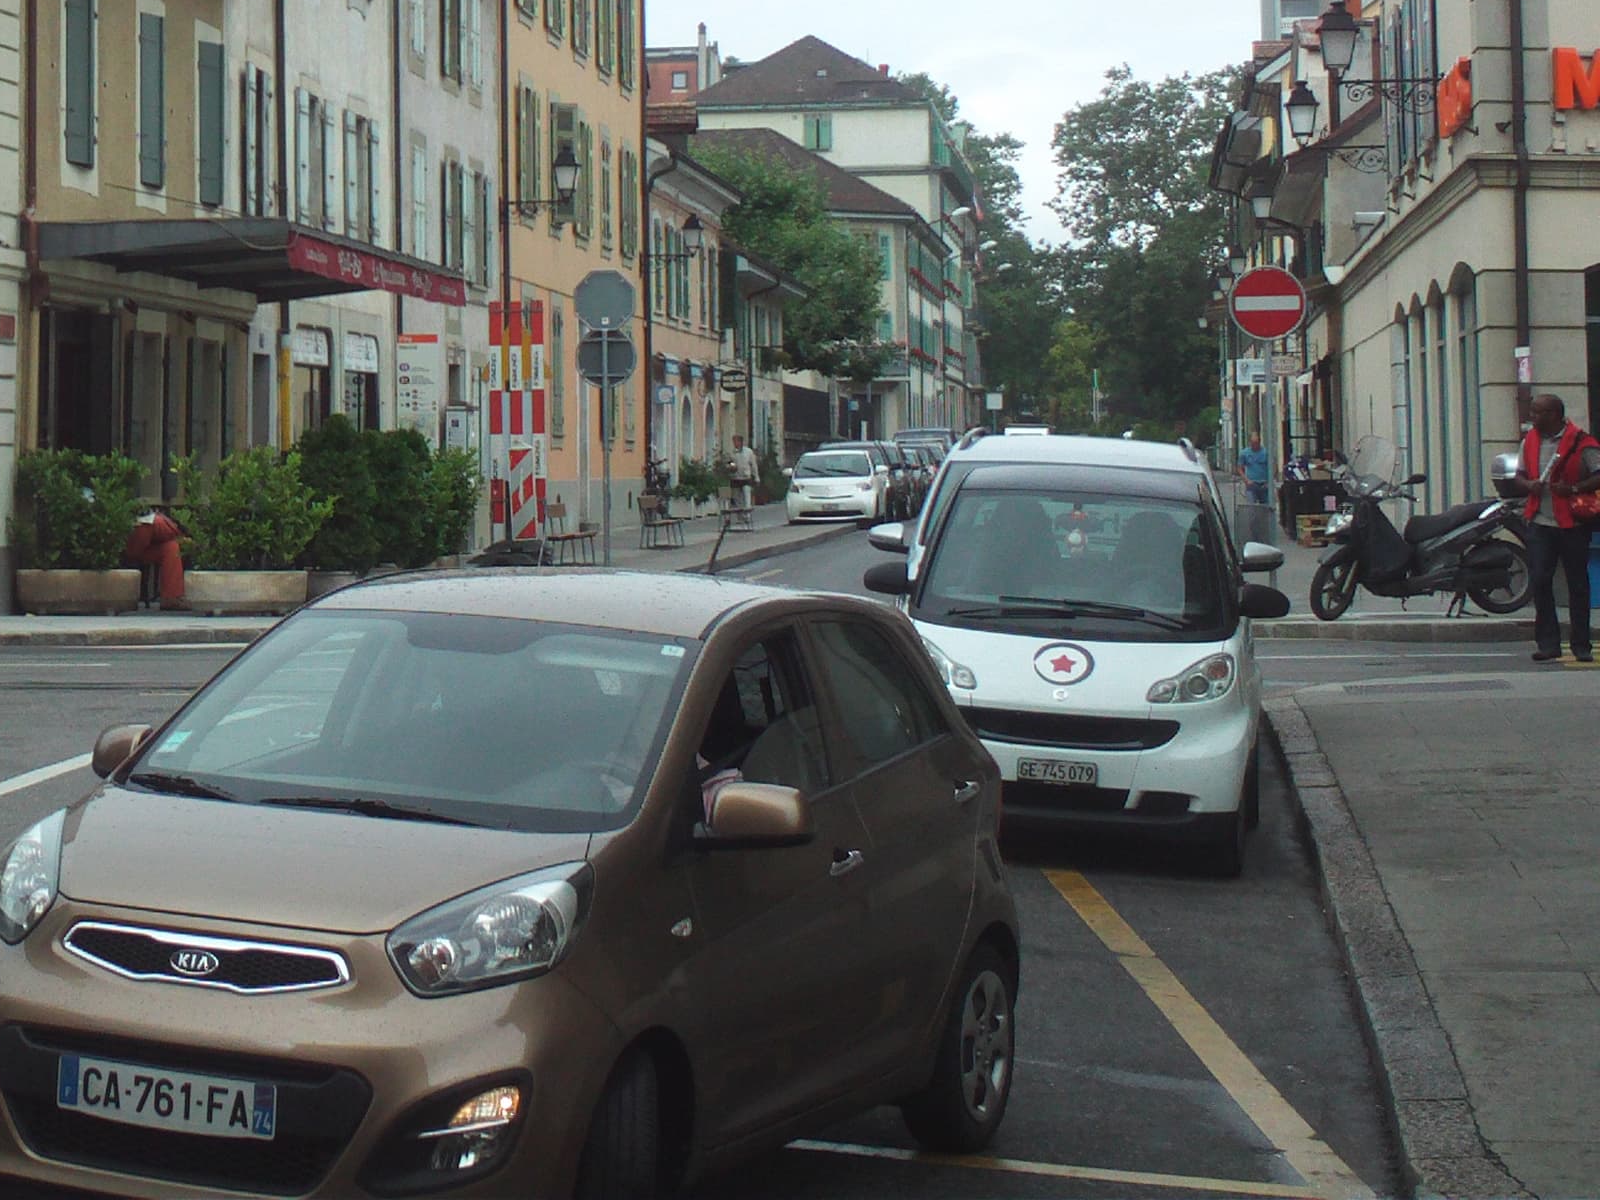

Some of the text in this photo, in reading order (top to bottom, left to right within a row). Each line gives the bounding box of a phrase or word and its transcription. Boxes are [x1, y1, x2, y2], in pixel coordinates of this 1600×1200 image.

[178, 953, 209, 970] KIA
[82, 1067, 248, 1128] CA-761-FA
[254, 1111, 273, 1131] 74
